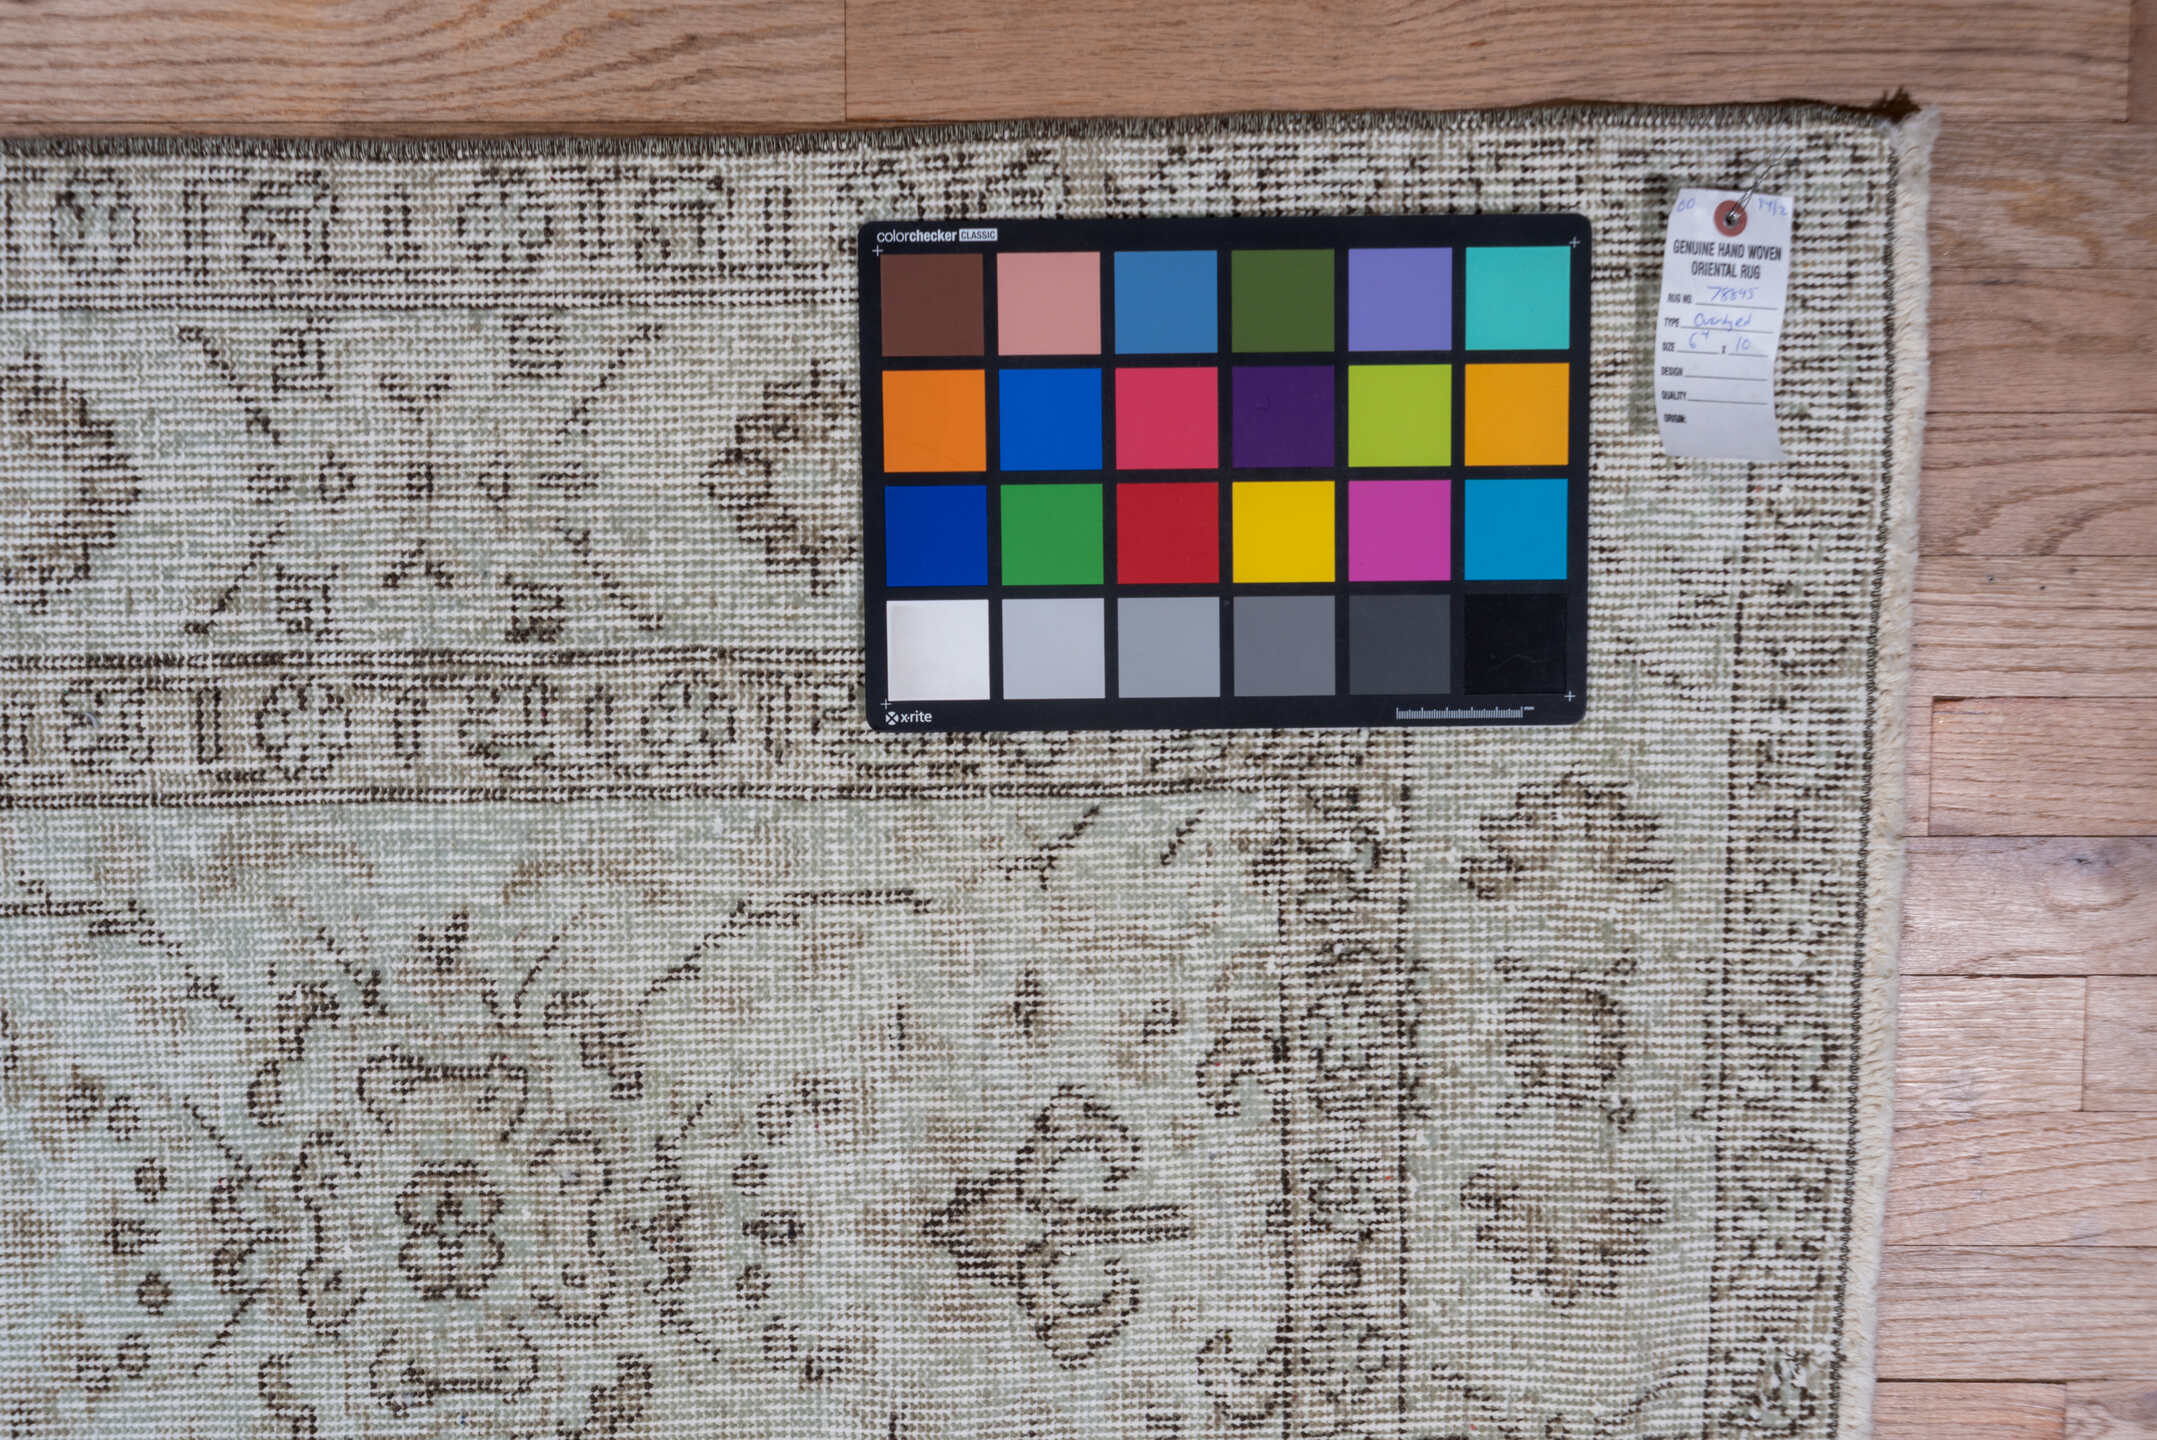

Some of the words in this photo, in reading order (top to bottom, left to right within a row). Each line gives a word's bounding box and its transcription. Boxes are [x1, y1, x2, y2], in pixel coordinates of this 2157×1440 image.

[877, 229, 957, 242] colorchecker
[960, 229, 996, 240] CLASSIC
[1673, 239, 1715, 256] GENUINE
[1718, 242, 1745, 259] HAND
[1747, 245, 1782, 261] WOVEN
[1691, 261, 1737, 278] ORIENTAL
[1740, 265, 1761, 280] RUG
[1664, 317, 1680, 328] TYPE
[1662, 342, 1675, 352] SIZE
[1661, 366, 1683, 376] DESIGN
[1661, 390, 1687, 400] QUALITY
